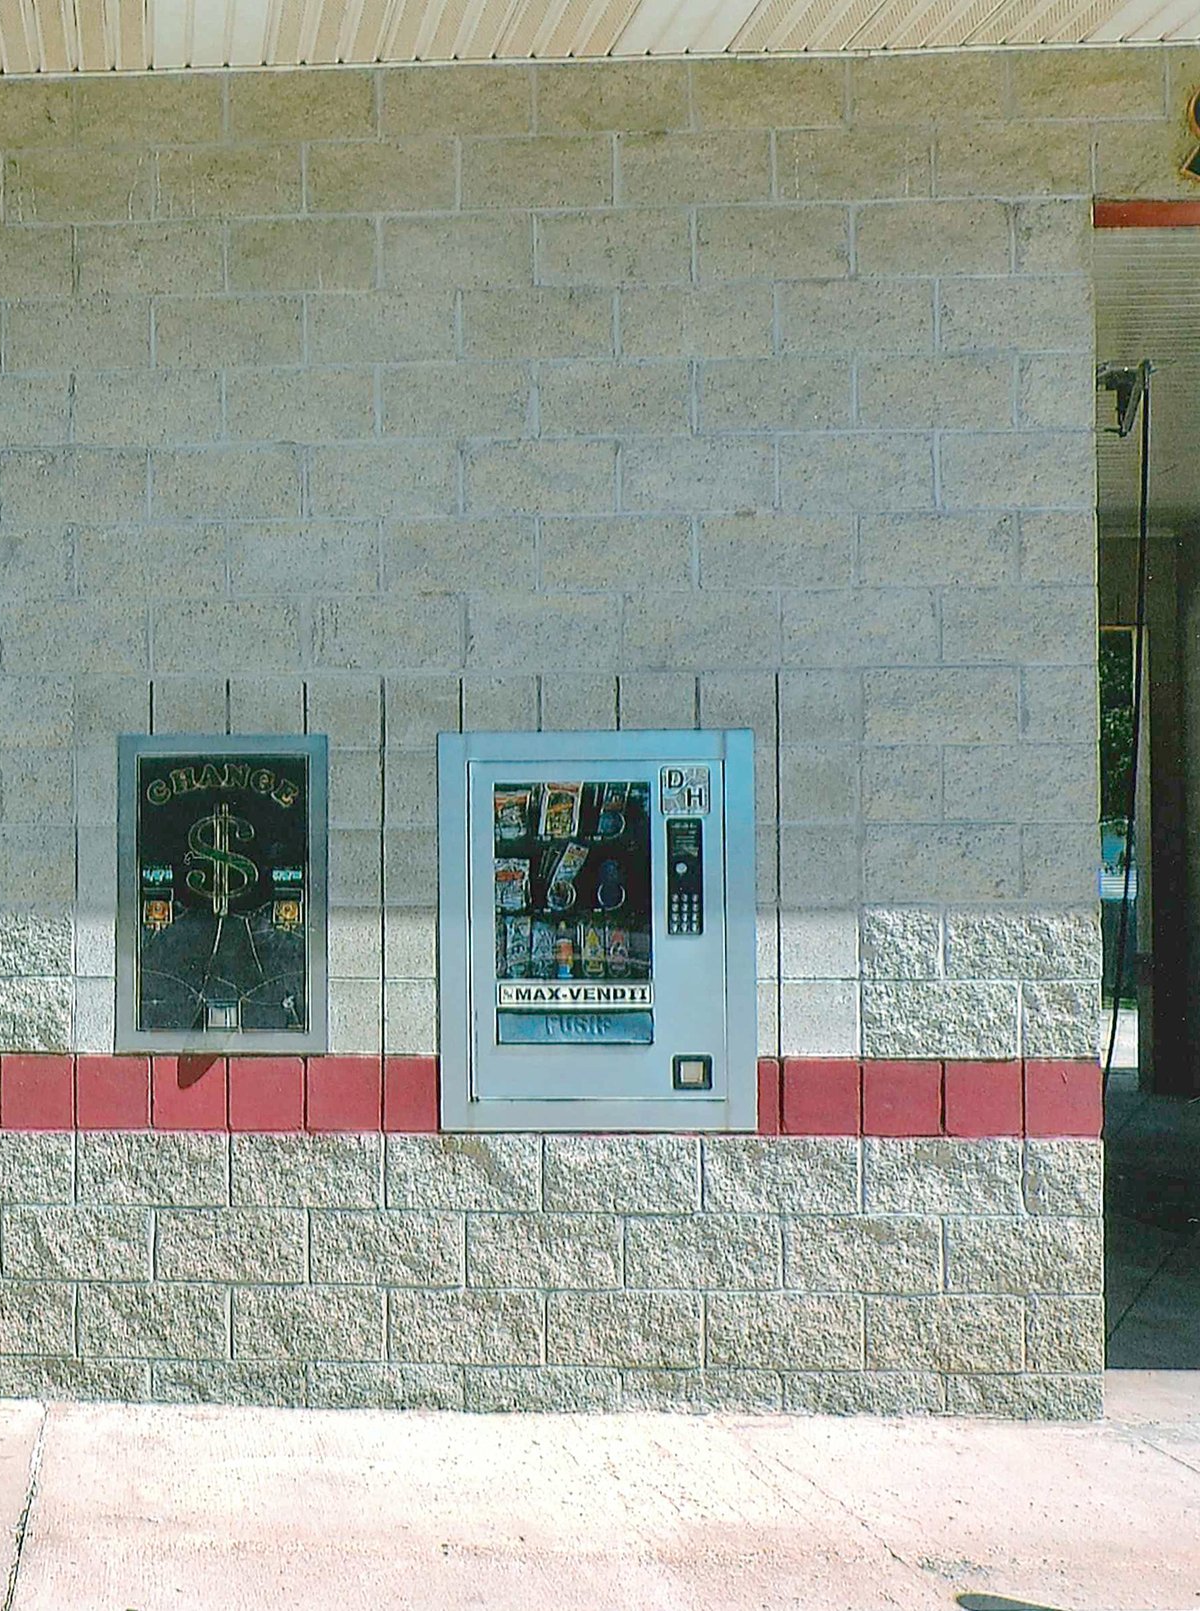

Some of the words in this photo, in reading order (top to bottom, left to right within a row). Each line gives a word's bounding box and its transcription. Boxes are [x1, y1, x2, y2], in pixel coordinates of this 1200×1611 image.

[147, 763, 299, 808] CHANGE
[667, 769, 685, 789] D
[686, 787, 705, 808] H
